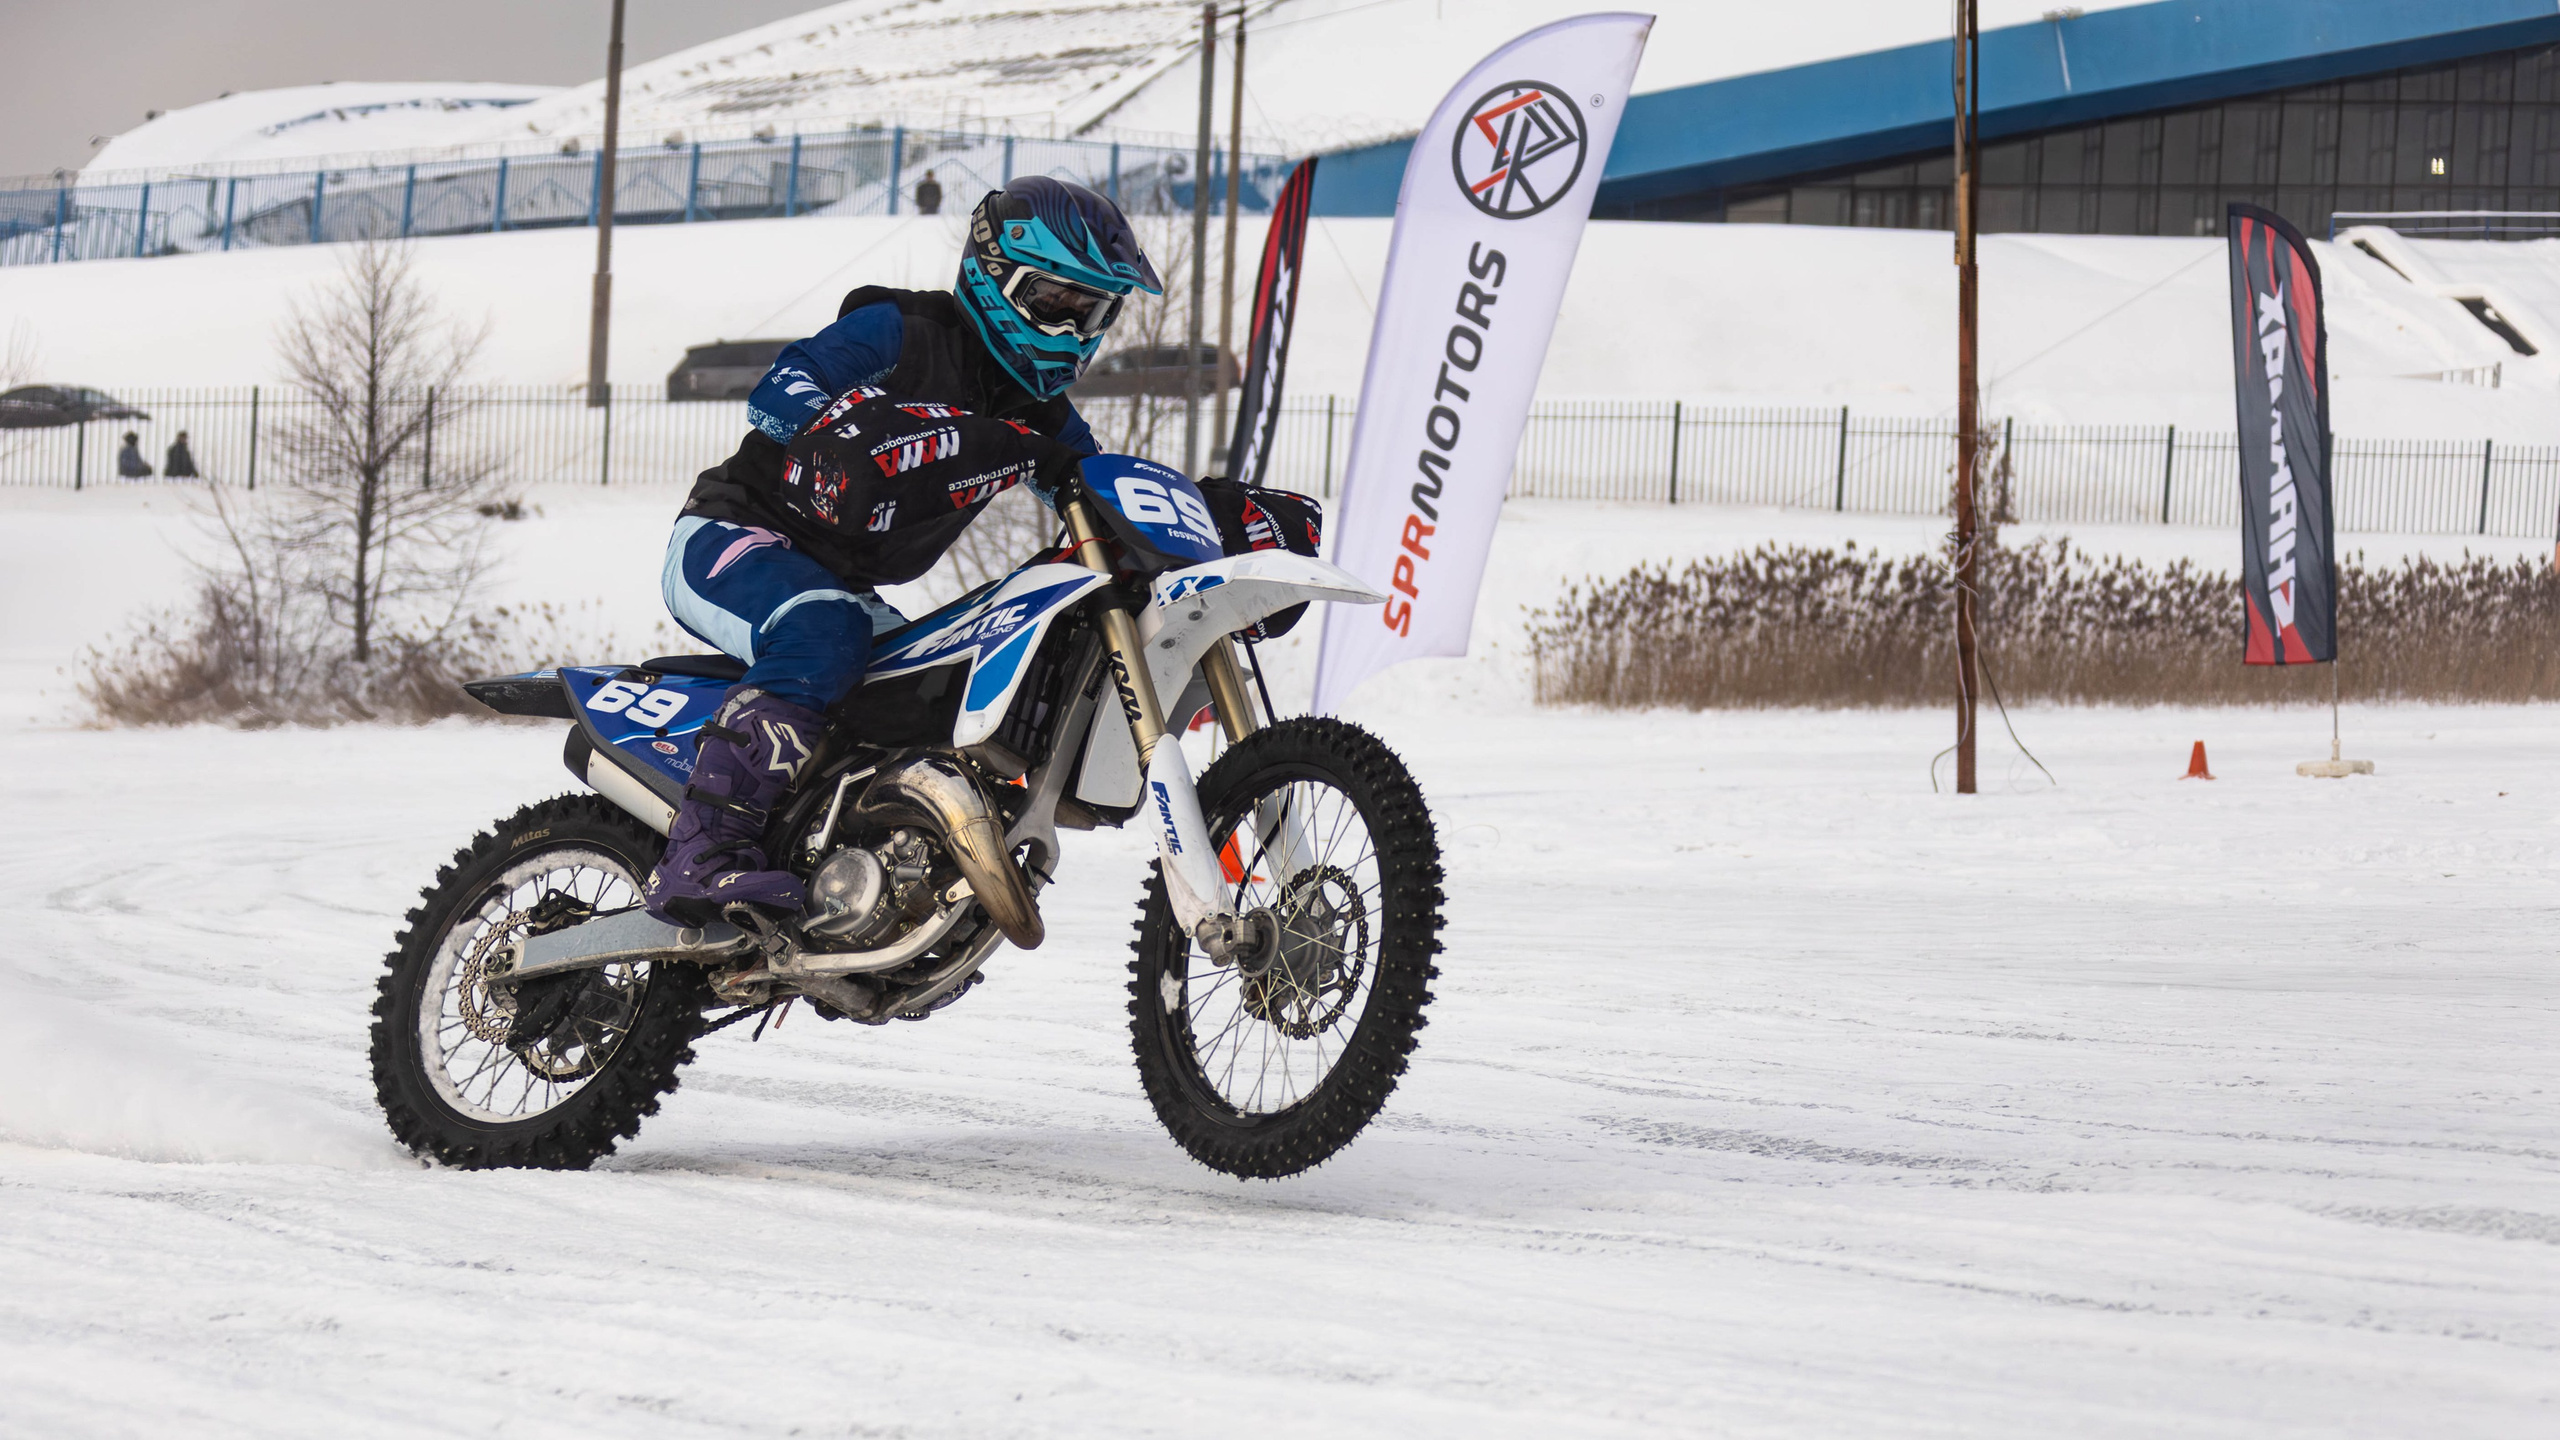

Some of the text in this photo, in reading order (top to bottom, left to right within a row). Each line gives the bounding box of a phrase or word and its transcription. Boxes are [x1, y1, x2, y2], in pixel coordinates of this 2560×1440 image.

[963, 256, 1024, 355] BELL
[874, 430, 960, 478] МАМА
[1382, 241, 1507, 637] SPRMOTORS
[1114, 476, 1221, 547] 69
[901, 603, 1029, 660] FANTIC
[976, 624, 1015, 642] RACING
[586, 679, 690, 728] 69
[655, 742, 676, 753] BELL
[510, 827, 551, 850] Mitas
[1151, 780, 1183, 856] FANTIC
